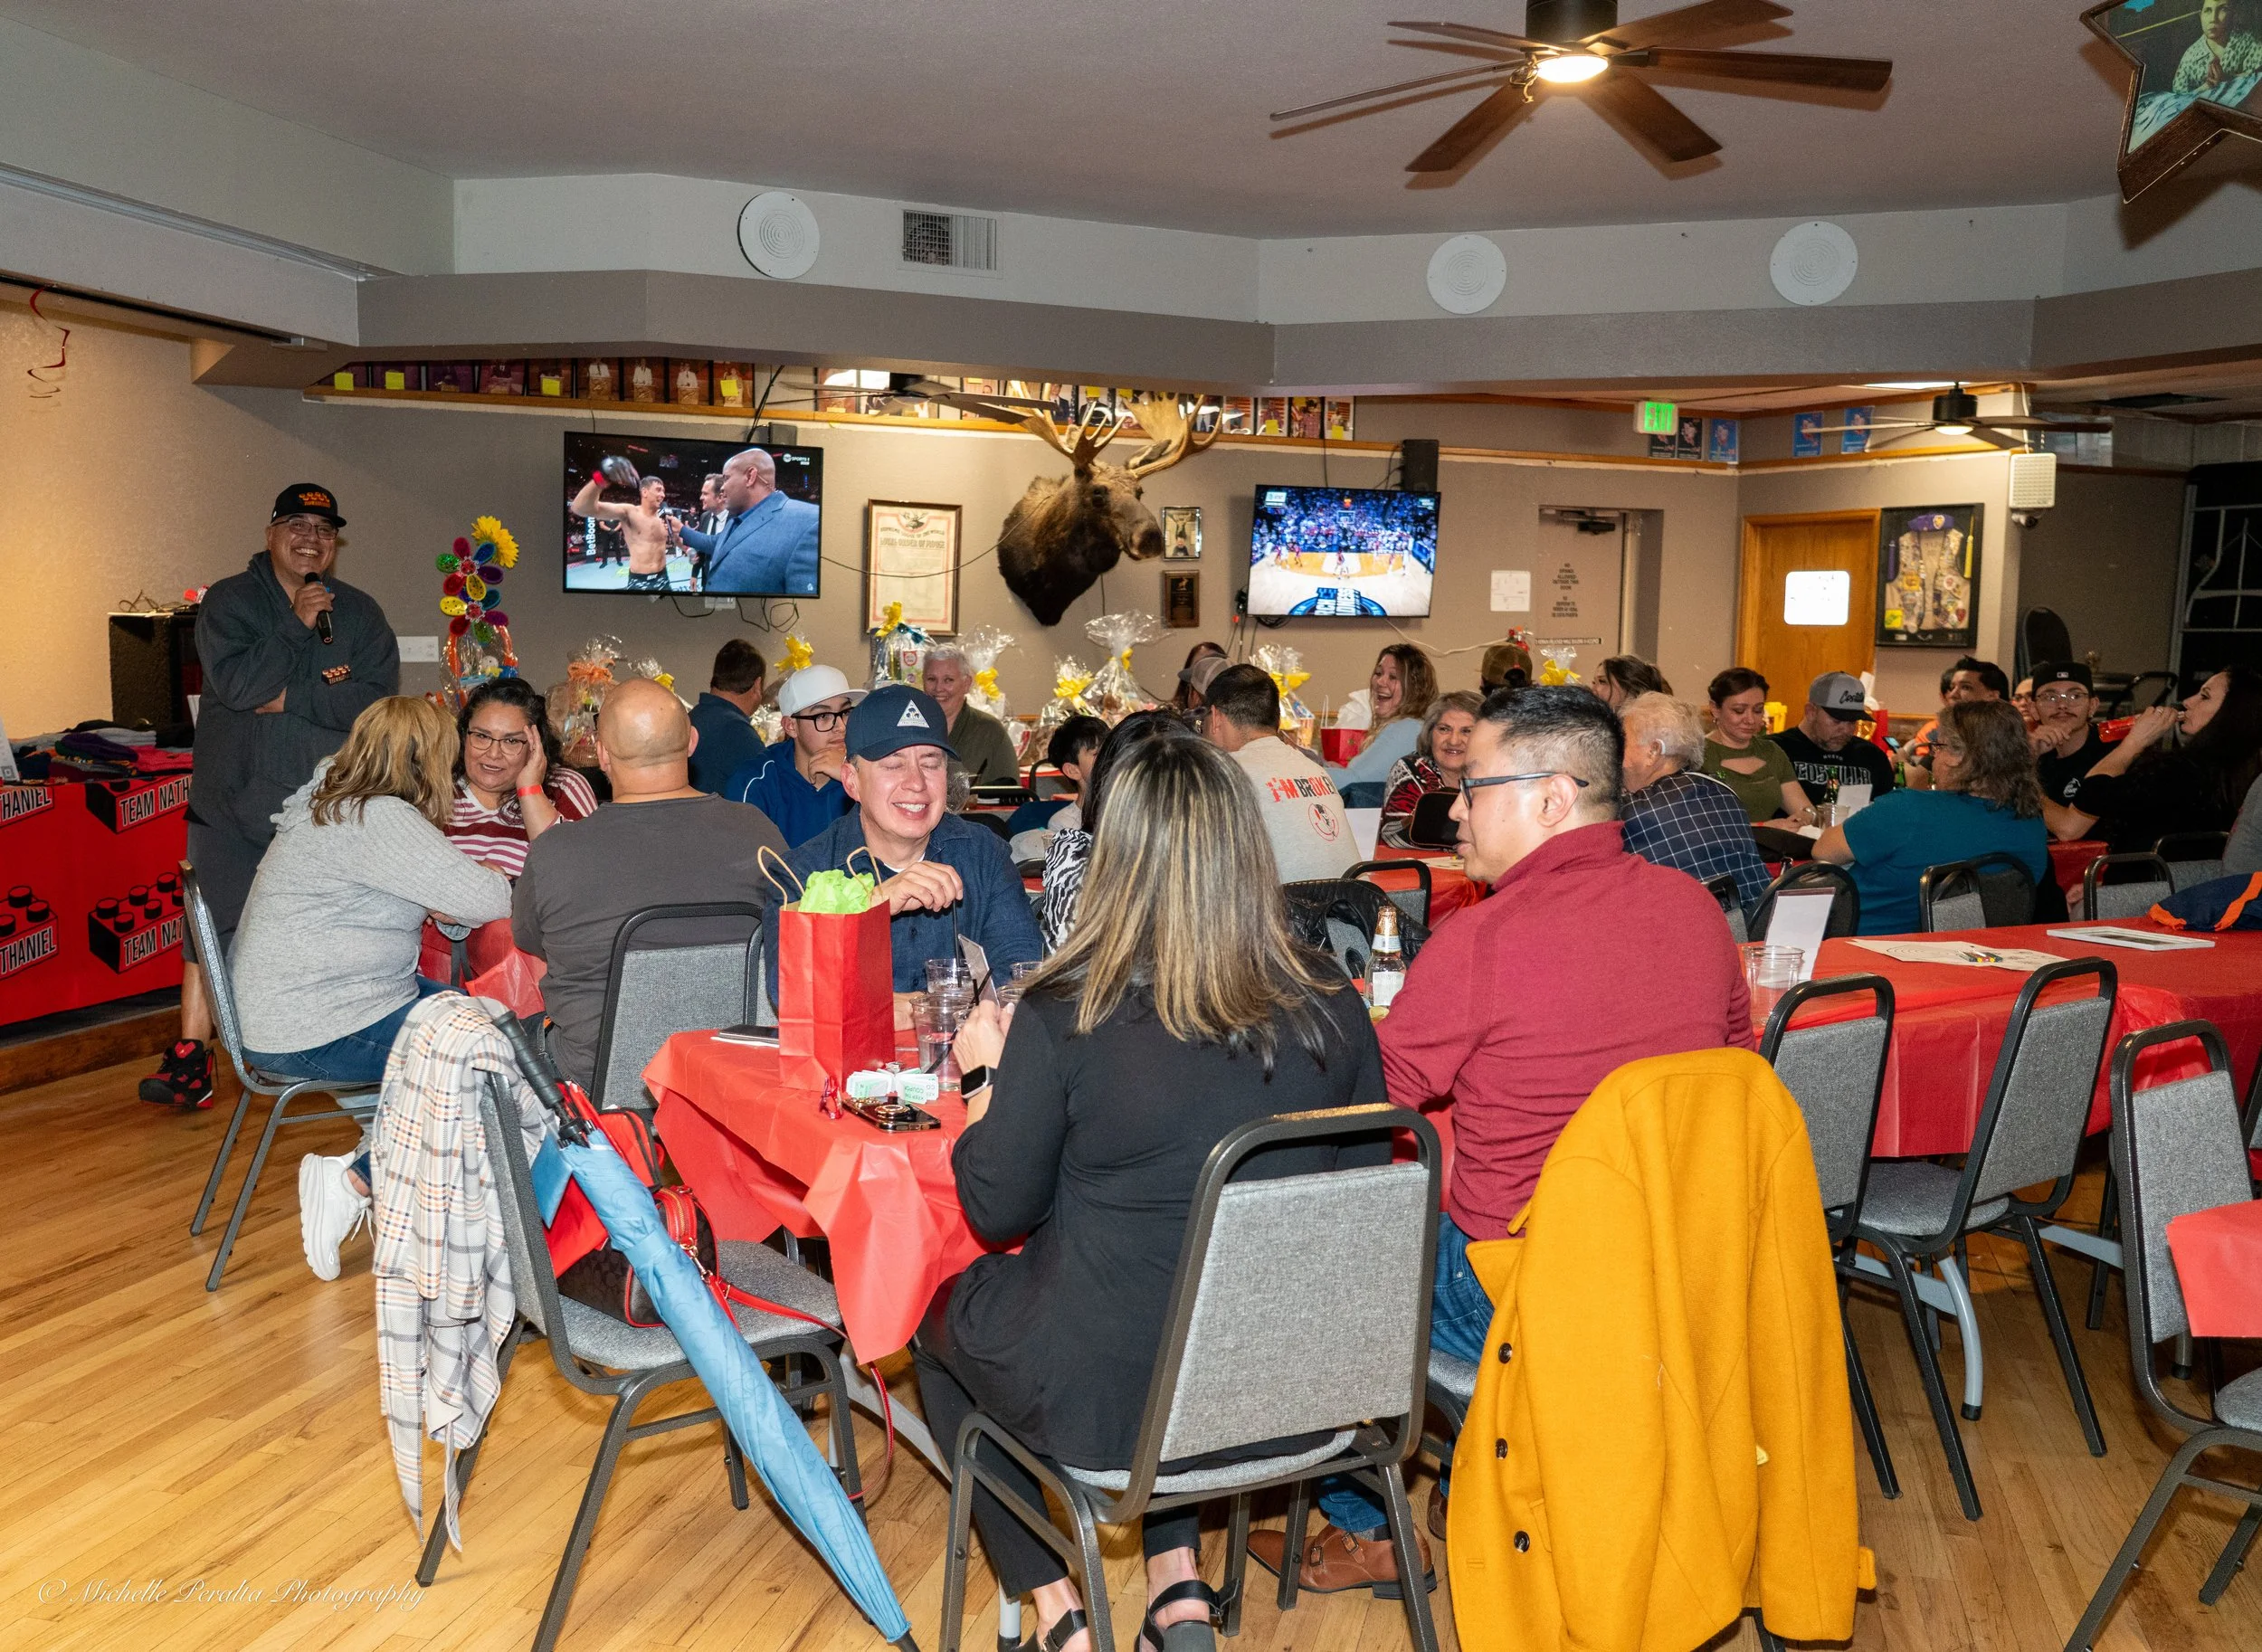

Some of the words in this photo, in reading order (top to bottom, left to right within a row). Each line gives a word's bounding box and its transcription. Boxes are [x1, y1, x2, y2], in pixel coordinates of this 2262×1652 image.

[1644, 402, 1675, 432] EXIT
[0, 786, 52, 821] HANIEL
[119, 788, 156, 827] TEAM
[0, 926, 57, 974] THANIEL
[124, 926, 157, 967] TEAM
